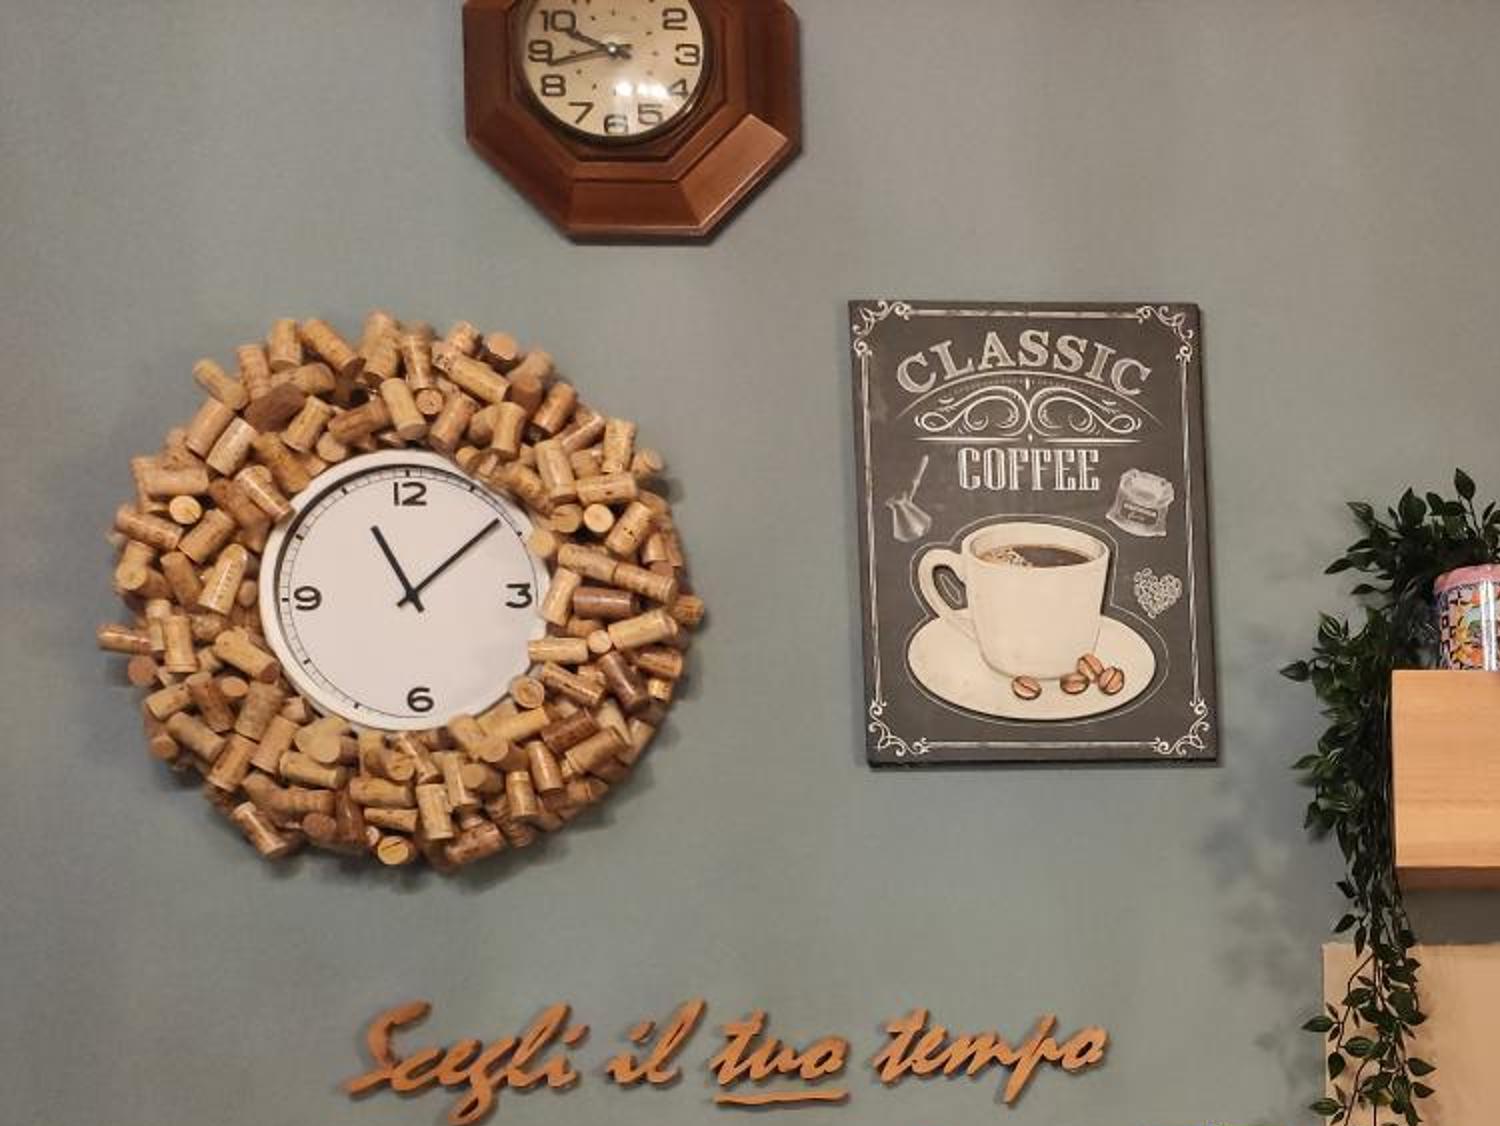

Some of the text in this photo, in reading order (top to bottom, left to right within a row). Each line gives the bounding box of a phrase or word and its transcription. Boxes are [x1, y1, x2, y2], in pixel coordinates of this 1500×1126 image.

[540, 10, 576, 33] 10
[662, 8, 688, 31] 2
[528, 39, 553, 64] 9
[675, 43, 700, 66] 3
[541, 74, 566, 97] 8
[670, 78, 688, 98] 4
[569, 102, 594, 124] 7
[603, 114, 628, 136] 6
[637, 103, 662, 125] 5
[897, 329, 1152, 396] CLASSIC
[958, 446, 1101, 491] COFFEE
[393, 482, 427, 507] 12
[293, 586, 322, 612] 9
[505, 582, 533, 609] 3
[406, 687, 434, 713] 6
[605, 996, 706, 1085] il
[710, 1008, 850, 1087] tuo
[873, 1008, 1108, 1105] tempo
